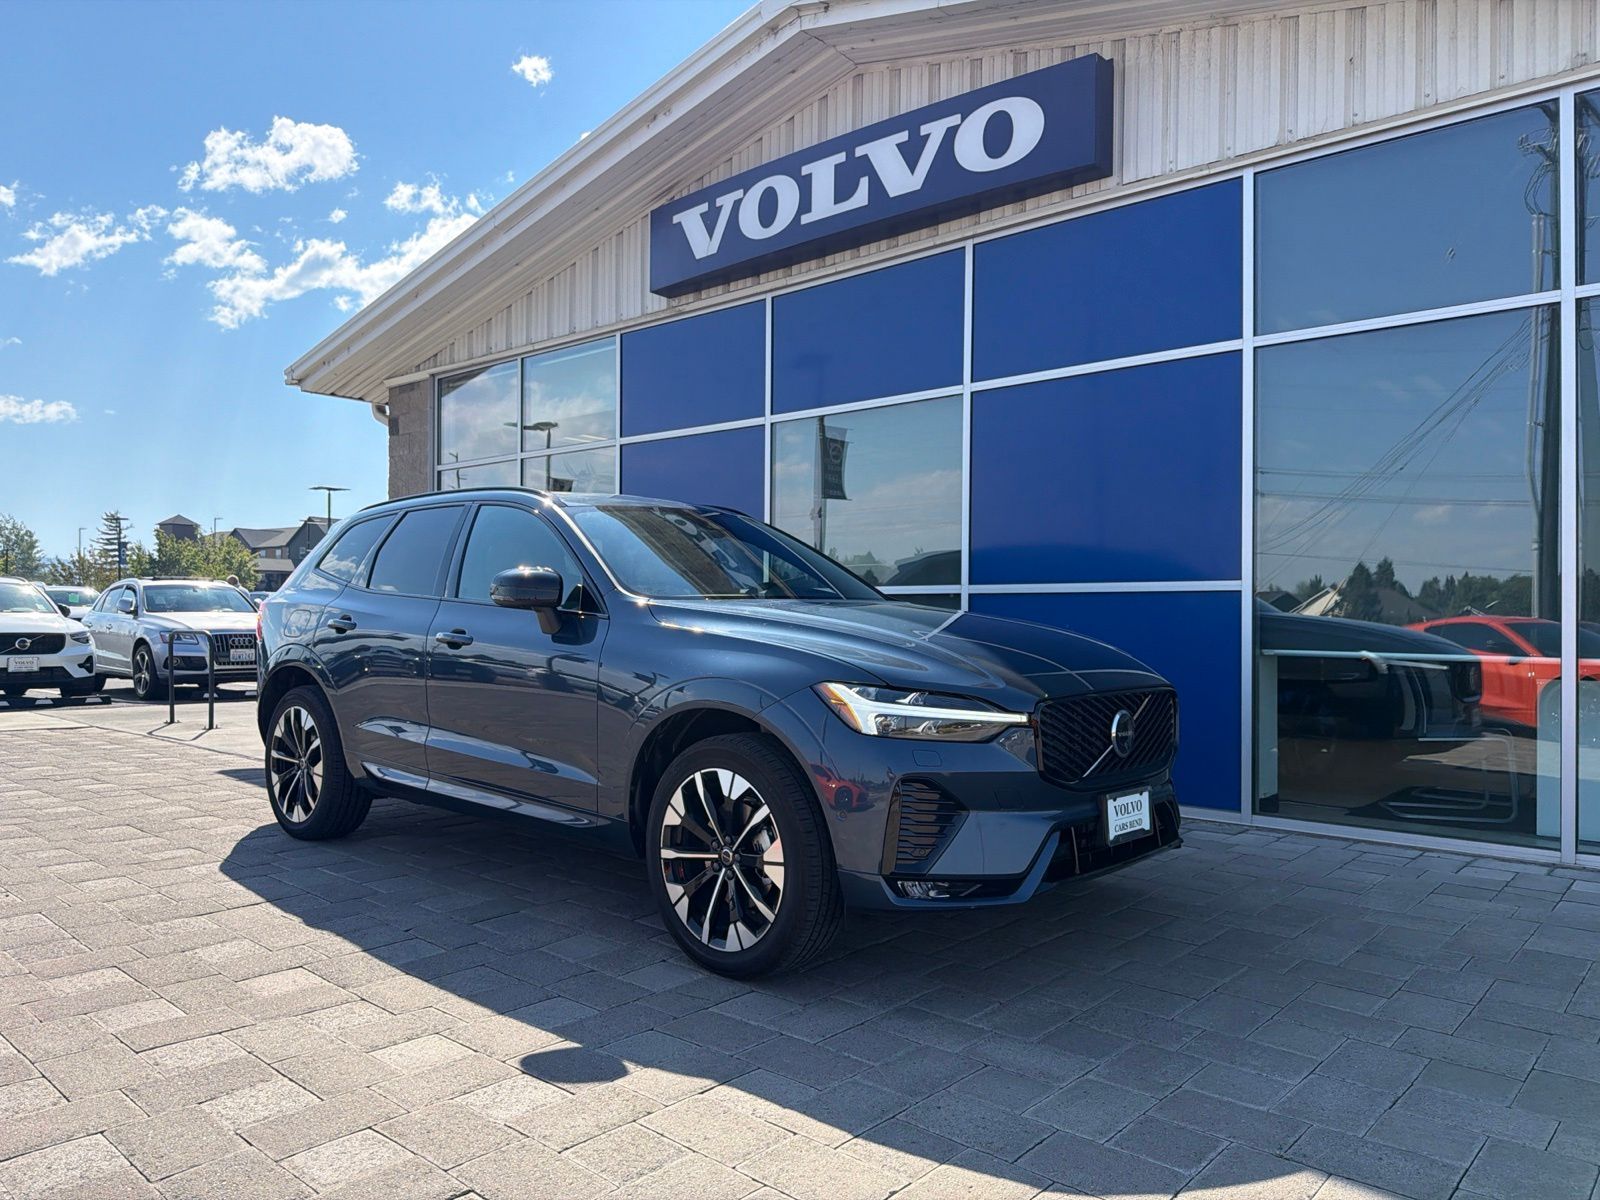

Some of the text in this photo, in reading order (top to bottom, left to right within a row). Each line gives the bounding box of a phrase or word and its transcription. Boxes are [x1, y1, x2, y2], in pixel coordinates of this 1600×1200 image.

[672, 96, 1045, 261] VOLVO
[1113, 799, 1143, 818] VOLVO
[1114, 818, 1143, 833] CARS BEND
